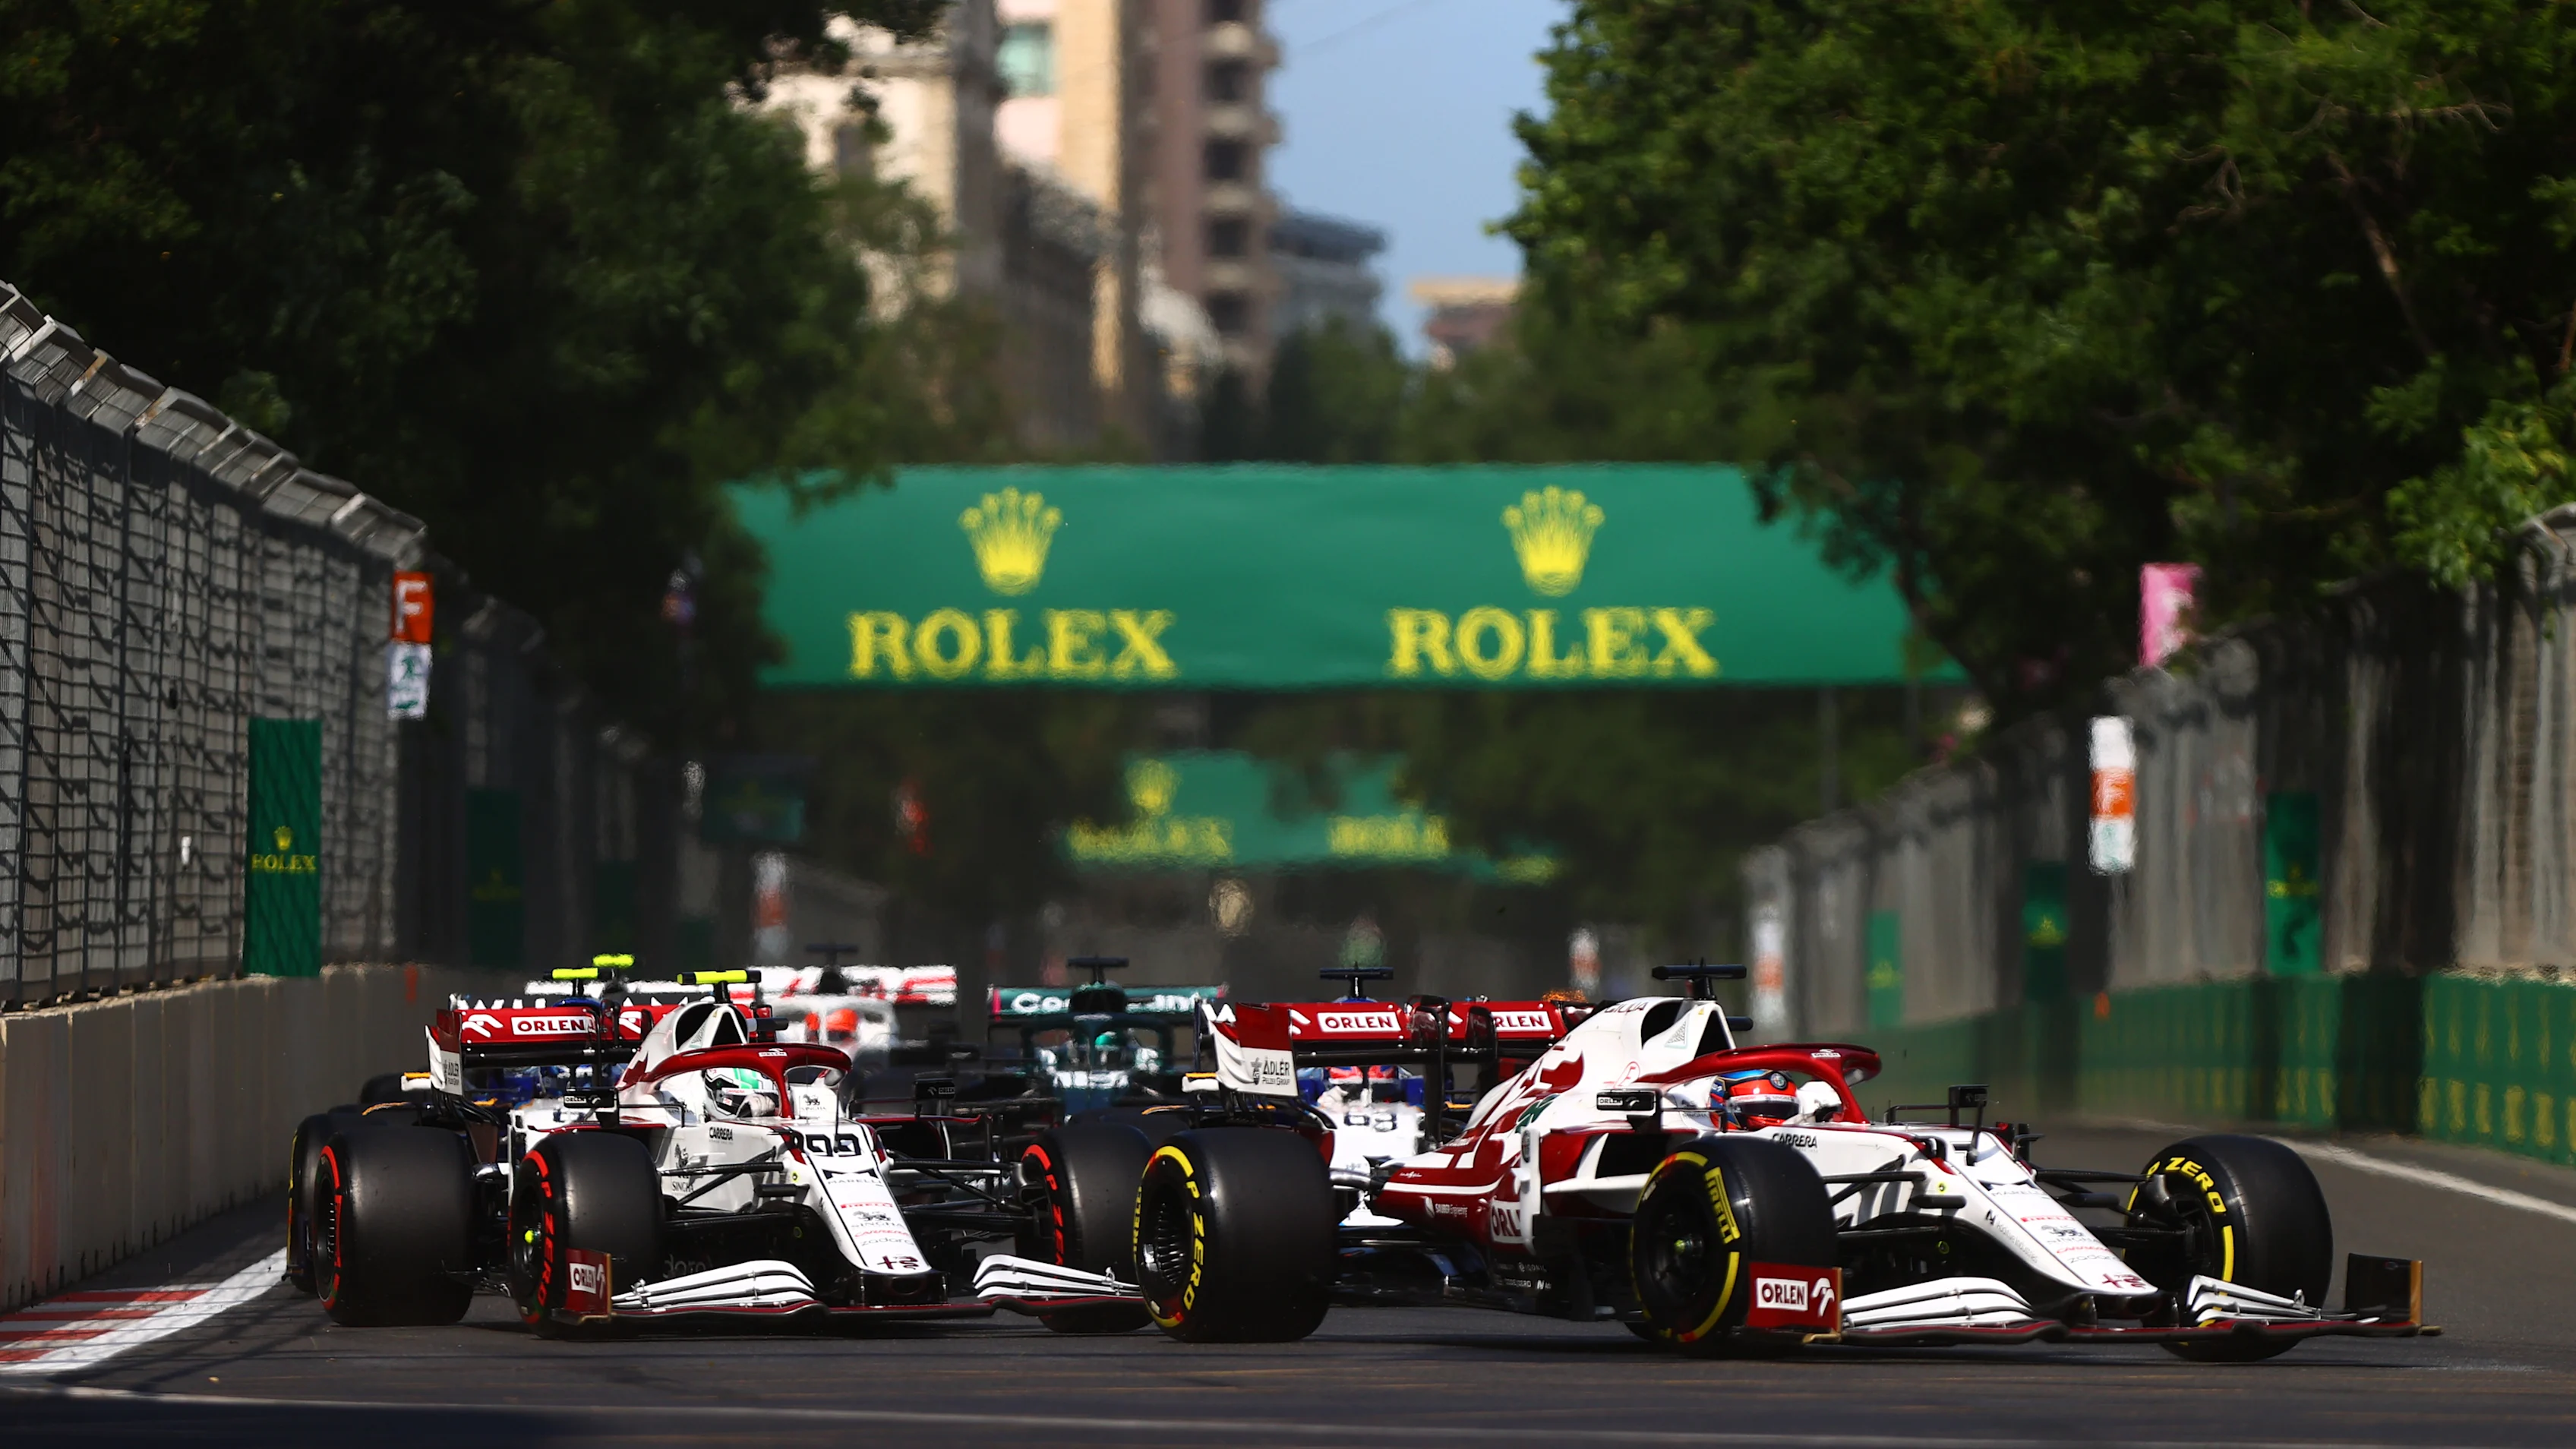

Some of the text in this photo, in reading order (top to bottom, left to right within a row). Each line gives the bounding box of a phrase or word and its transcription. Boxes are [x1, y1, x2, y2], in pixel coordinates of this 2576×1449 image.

[846, 608, 1176, 679] ROLEX
[1387, 607, 1719, 679] ROLEX
[251, 853, 316, 873] ROLEX
[516, 1018, 587, 1033] ORLEN
[1324, 1016, 1393, 1028] ORLEN
[1493, 1015, 1545, 1028] RLEN
[709, 1126, 734, 1141] CARRERA
[1772, 1132, 1818, 1148] CARRERA
[2165, 1157, 2227, 1214] ZERO
[1492, 1205, 1522, 1237] ORL
[537, 1212, 555, 1307] ZERO
[1183, 1213, 1205, 1311] ZERO
[1762, 1283, 1805, 1305] ORLEN
